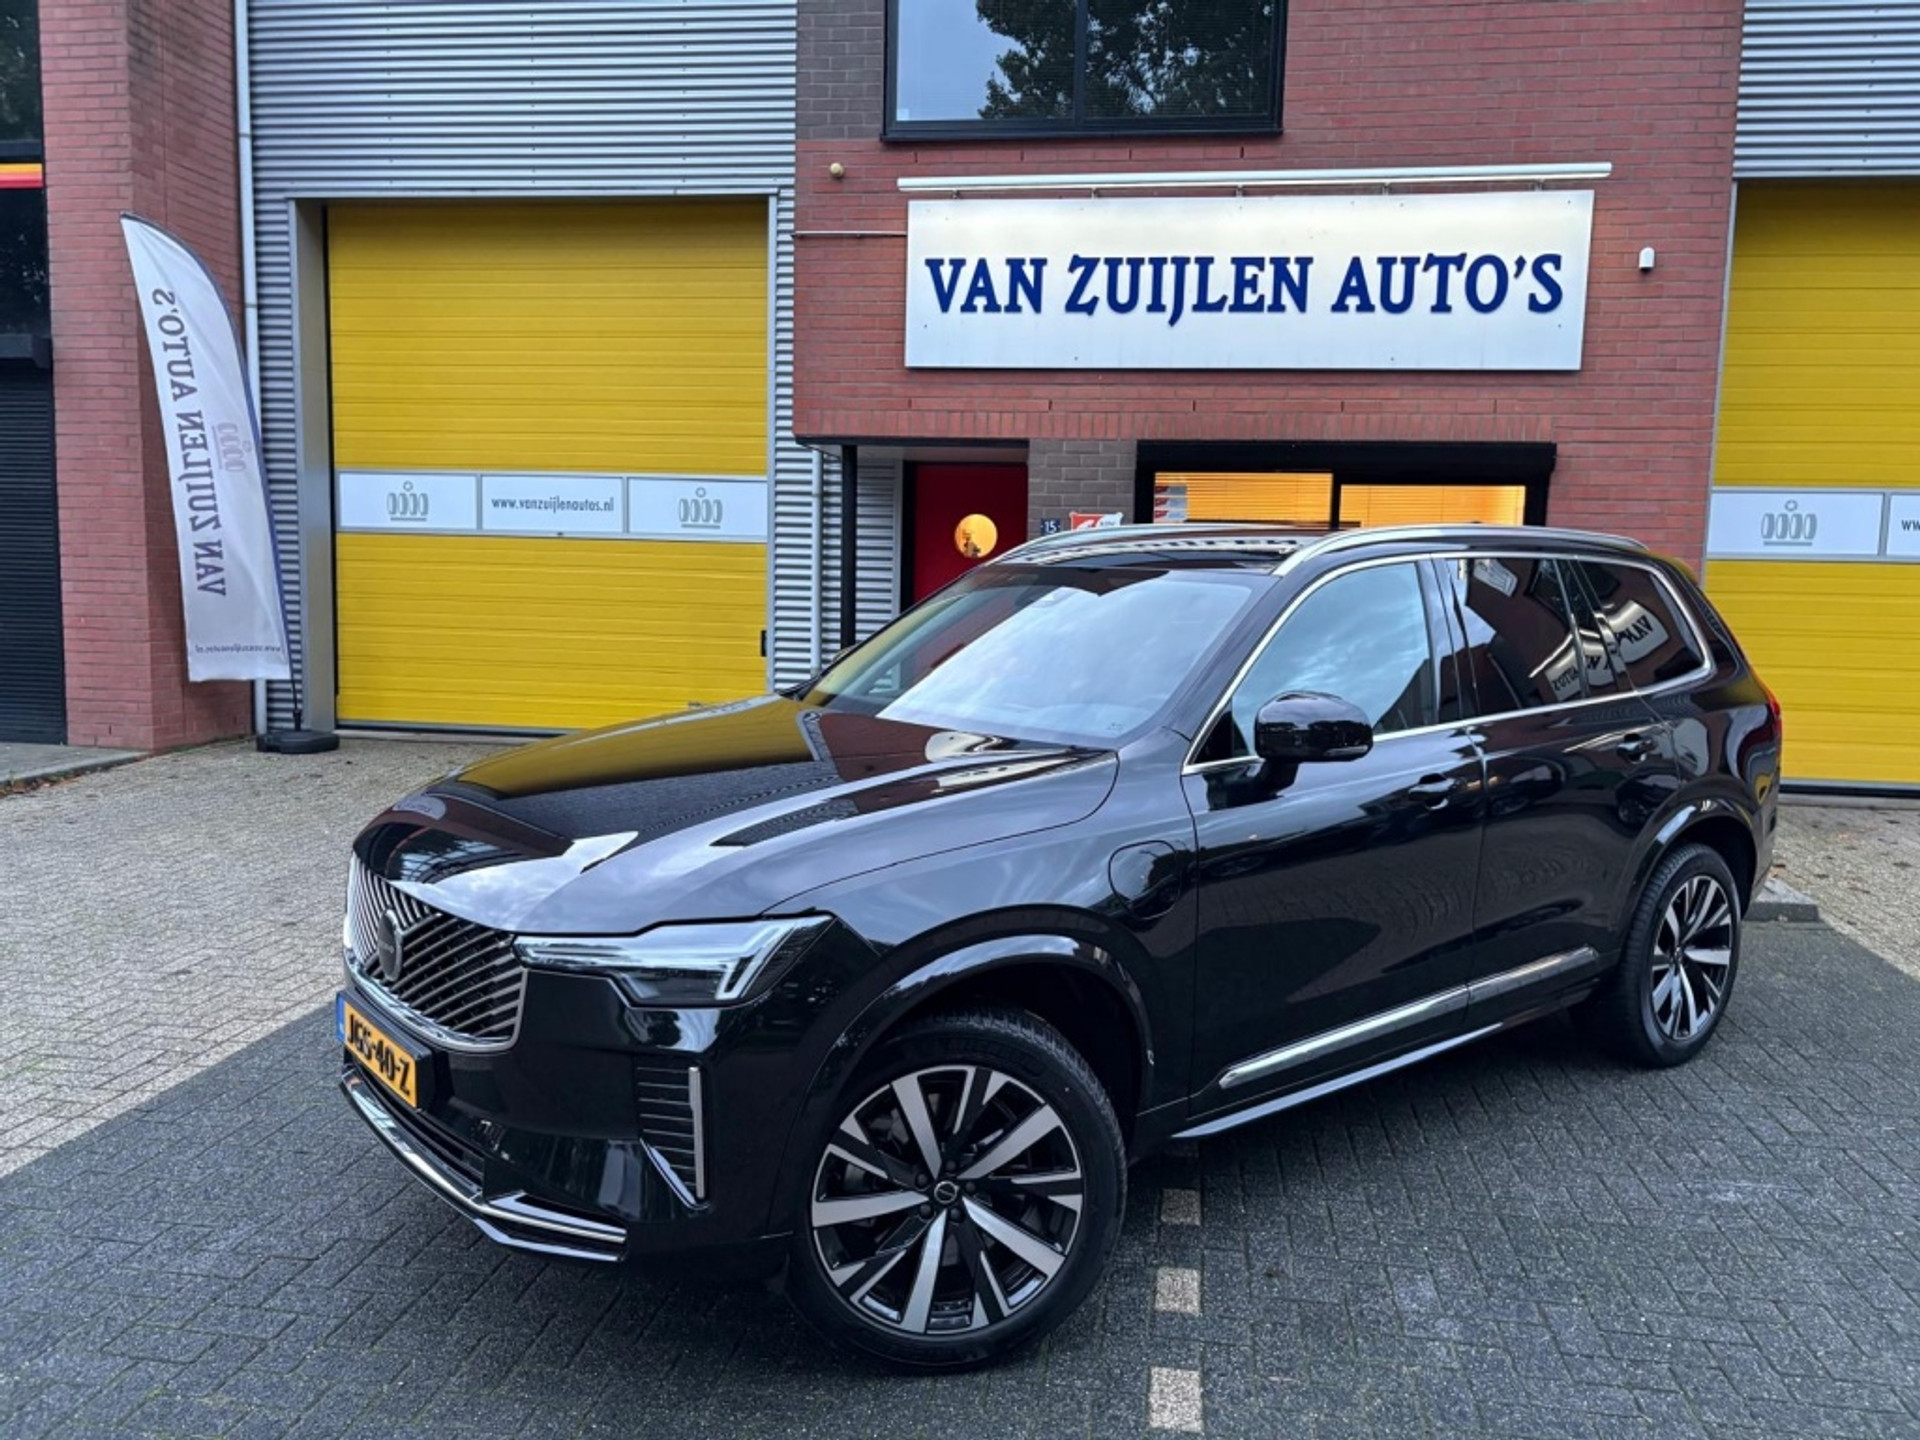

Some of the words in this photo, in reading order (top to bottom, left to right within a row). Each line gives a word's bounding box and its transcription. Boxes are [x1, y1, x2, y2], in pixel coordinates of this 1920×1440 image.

[925, 257, 1047, 314] VAN
[1065, 254, 1313, 326] ZUIJLEN
[1331, 253, 1563, 314] AUTO'S
[491, 496, 614, 514] www.vanzuijlenautos.nl
[1044, 521, 1057, 533] 15
